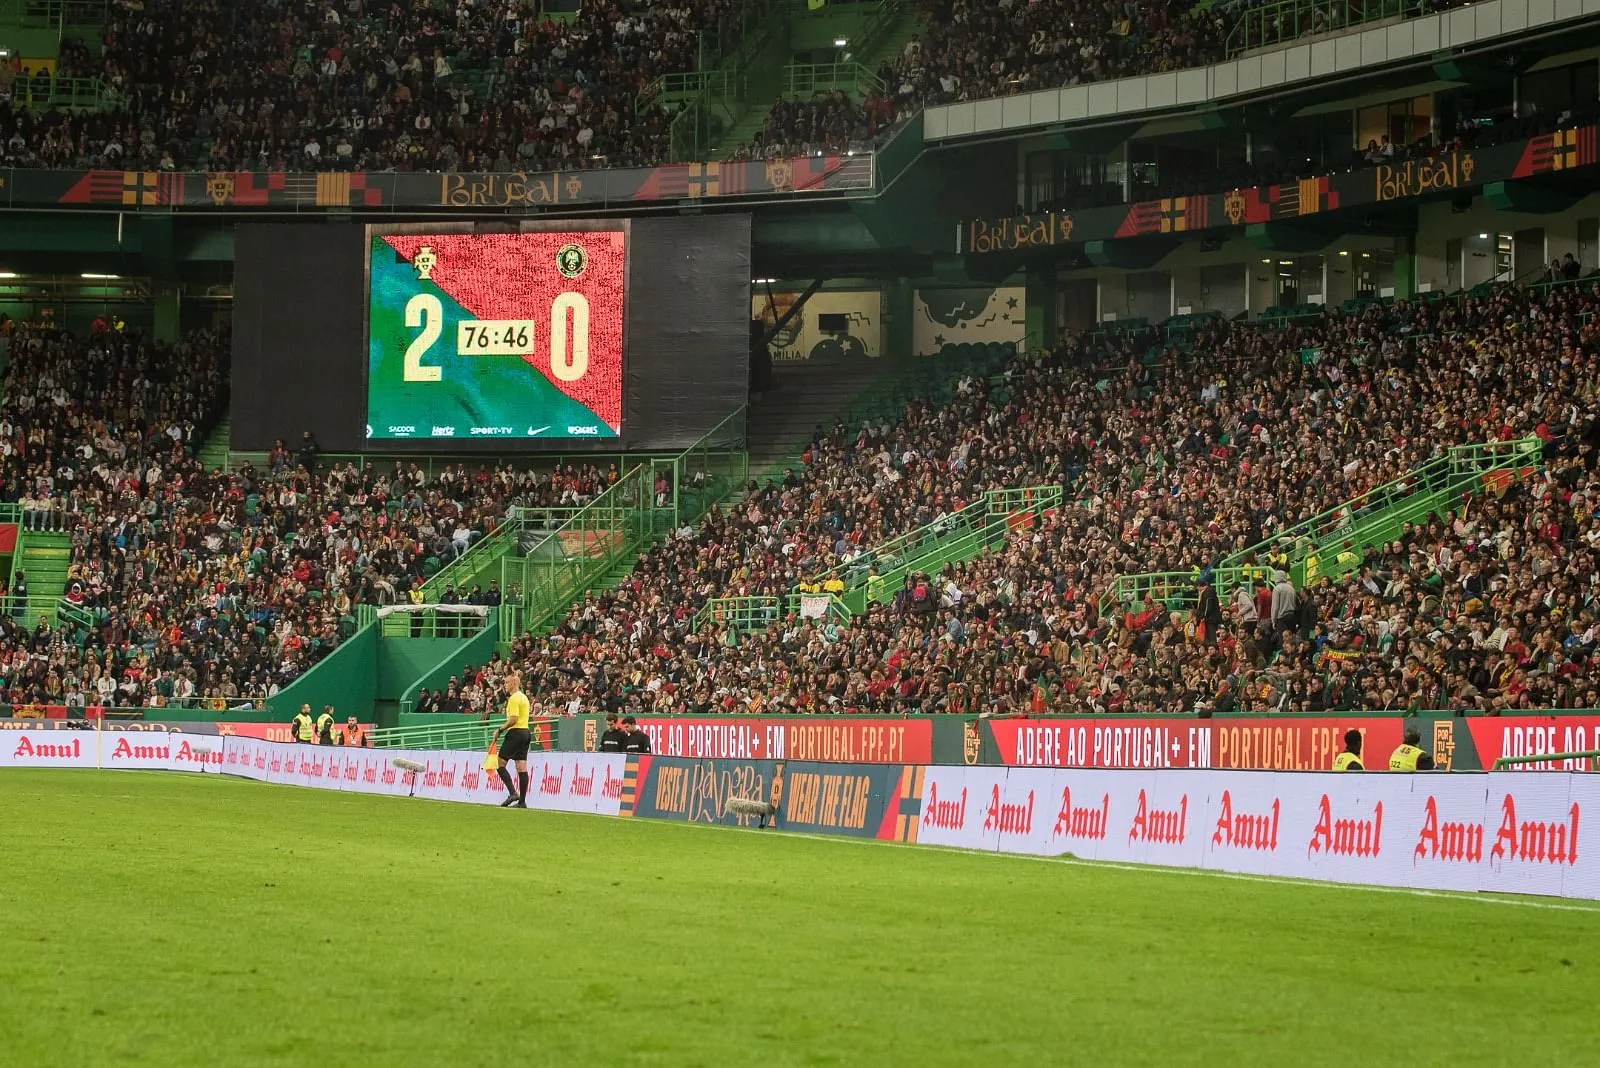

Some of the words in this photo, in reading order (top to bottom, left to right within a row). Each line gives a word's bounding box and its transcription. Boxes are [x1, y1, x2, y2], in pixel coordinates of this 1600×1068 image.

[404, 294, 443, 381] 2
[465, 327, 528, 348] 76:46
[550, 292, 590, 381] 0
[13, 736, 80, 759] Amul
[112, 737, 169, 760] Amu
[668, 725, 683, 757] AO
[688, 725, 760, 758] PORTUGAL+
[766, 725, 785, 759] EM
[790, 726, 905, 762] PORTUGAL.FPF.PT
[1016, 727, 1061, 766] ADERE
[1067, 727, 1086, 766] AO
[1093, 727, 1180, 768] PORTUGAL+
[1189, 727, 1211, 769] EM
[1502, 726, 1556, 771] ADERE
[1563, 725, 1586, 771] AO
[540, 761, 563, 797] Amul
[569, 762, 594, 800] Amul
[656, 765, 682, 812] VESTE
[679, 767, 690, 813] A
[786, 772, 821, 825] WEAR
[818, 774, 843, 827] THE
[838, 775, 871, 829] FLAG
[923, 781, 967, 832] Amul
[983, 783, 1034, 837] Amul
[1053, 785, 1109, 843] Amul
[1128, 788, 1188, 848] Amul
[1211, 789, 1280, 853] Amul
[1308, 793, 1383, 861] Amul
[1413, 795, 1484, 869] Amu
[1491, 793, 1579, 869] Amul
